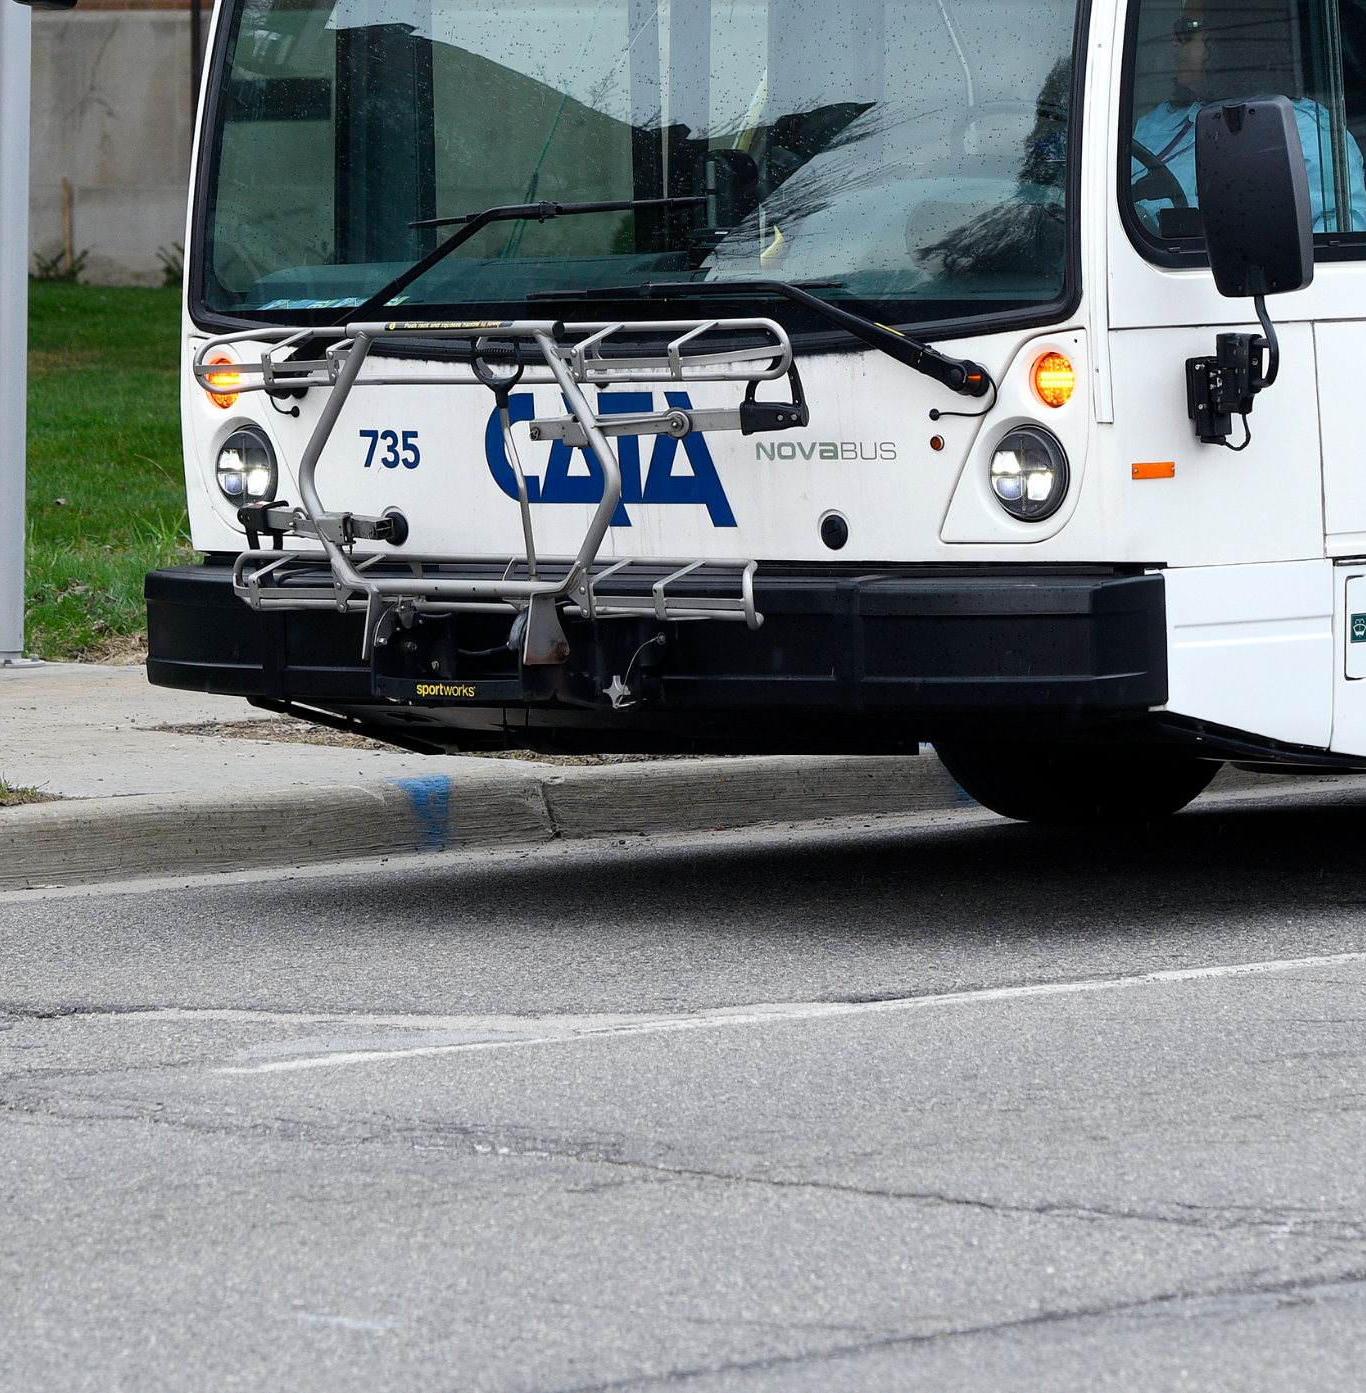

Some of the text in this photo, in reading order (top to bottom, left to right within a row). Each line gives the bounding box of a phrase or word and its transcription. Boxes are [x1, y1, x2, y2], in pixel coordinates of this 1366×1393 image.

[359, 429, 421, 470] 735
[485, 392, 737, 527] CATA
[416, 683, 474, 698] sportworks
